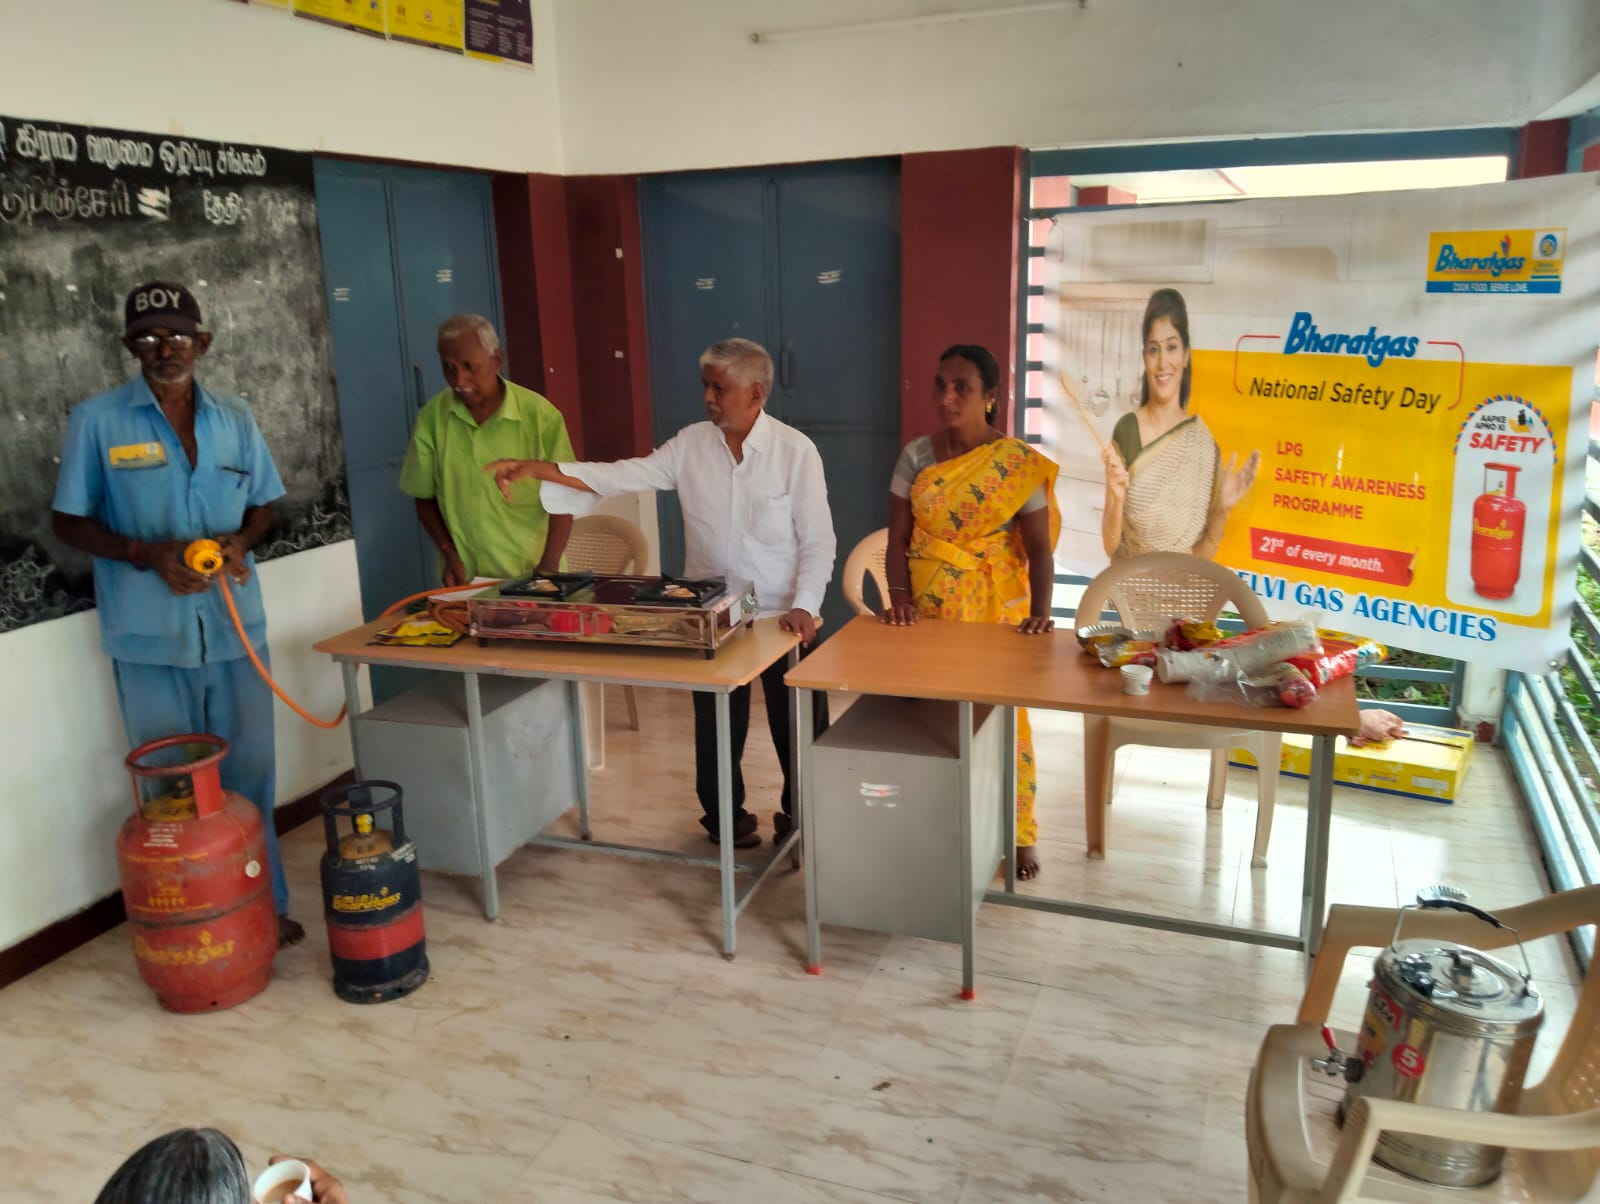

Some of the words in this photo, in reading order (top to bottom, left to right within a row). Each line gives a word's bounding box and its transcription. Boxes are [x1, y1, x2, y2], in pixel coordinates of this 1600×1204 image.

[1434, 244, 1525, 278] Bharatgas
[135, 288, 181, 312] BOY
[1283, 311, 1420, 368] Bharatgas
[1249, 377, 1326, 401] National
[1330, 382, 1394, 410] Safety
[1399, 387, 1441, 414] Day
[1276, 441, 1303, 457] LPG
[1469, 432, 1545, 454] SAFETY
[1275, 468, 1328, 487] SAFETY
[1331, 474, 1426, 501] AWARENESS
[1273, 494, 1364, 520] PROGRAMME
[1259, 536, 1285, 554] 21st
[1286, 544, 1301, 557] of
[1302, 550, 1337, 566] every
[1338, 556, 1384, 573] month.
[1295, 583, 1344, 612] GAS
[1353, 595, 1497, 642] AGENCIES
[1401, 1048, 1419, 1068] 5
